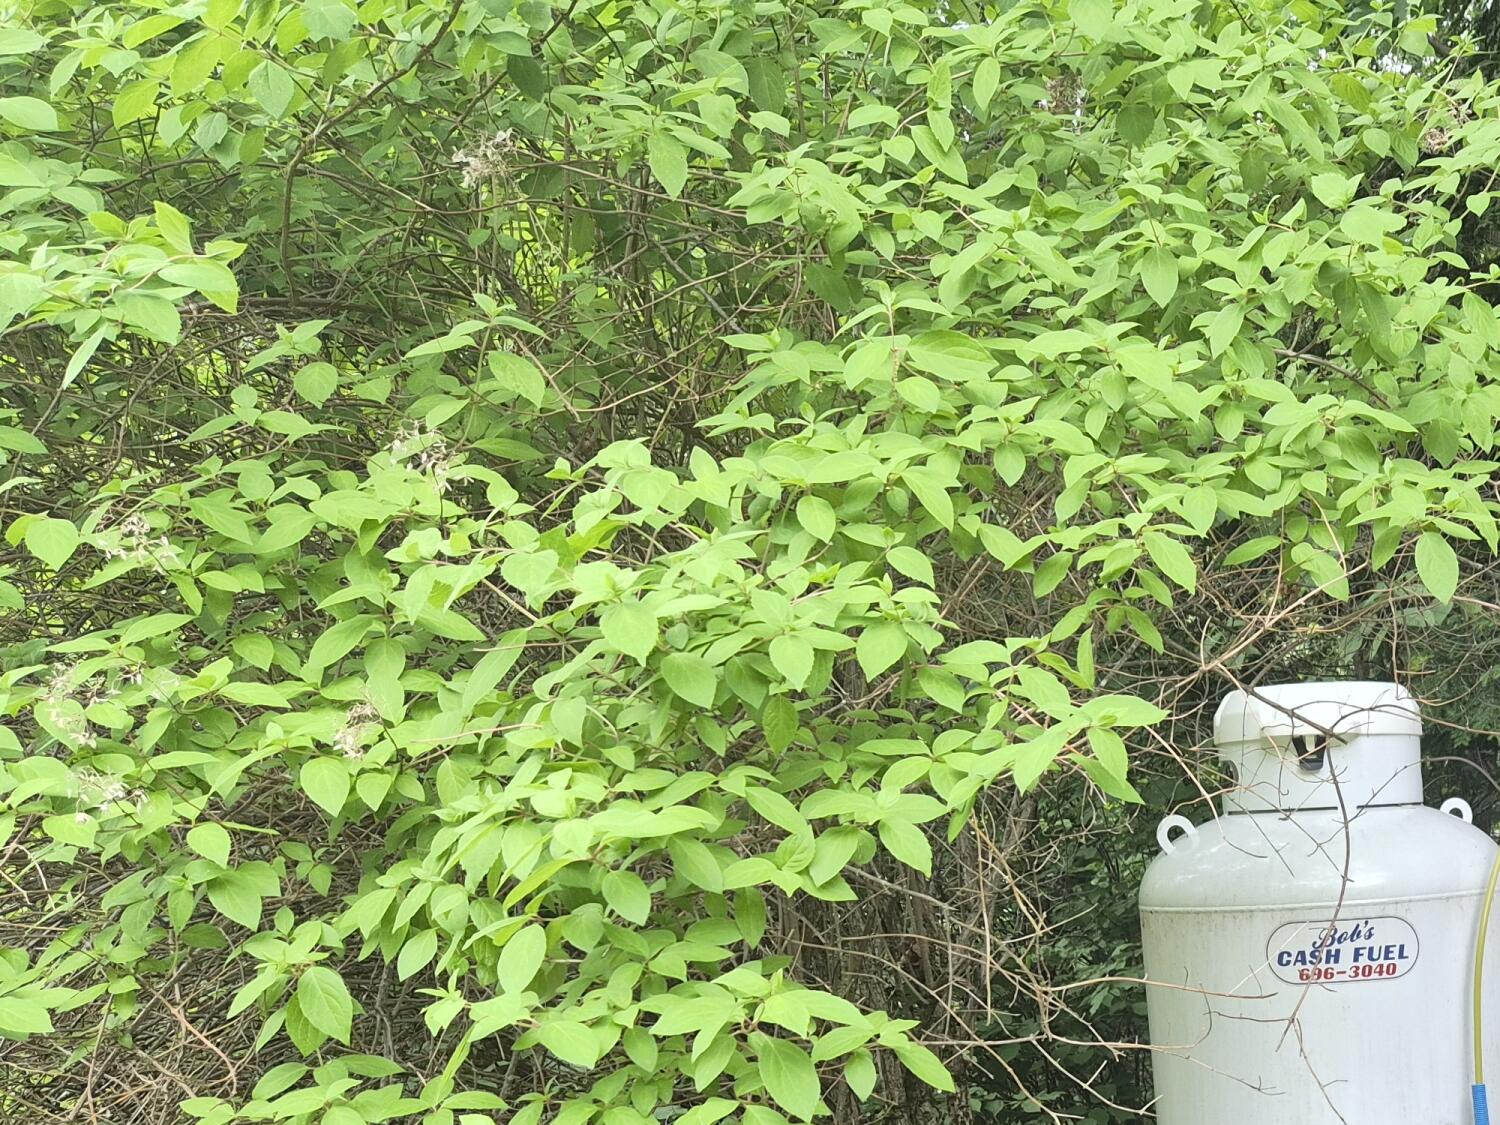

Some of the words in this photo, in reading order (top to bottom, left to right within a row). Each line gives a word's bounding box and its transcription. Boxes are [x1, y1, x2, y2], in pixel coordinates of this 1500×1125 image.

[1311, 920, 1375, 949] Bob's
[1277, 948, 1341, 967] CASH
[1352, 944, 1409, 963] FUEL
[1298, 963, 1397, 981] 696-3040
